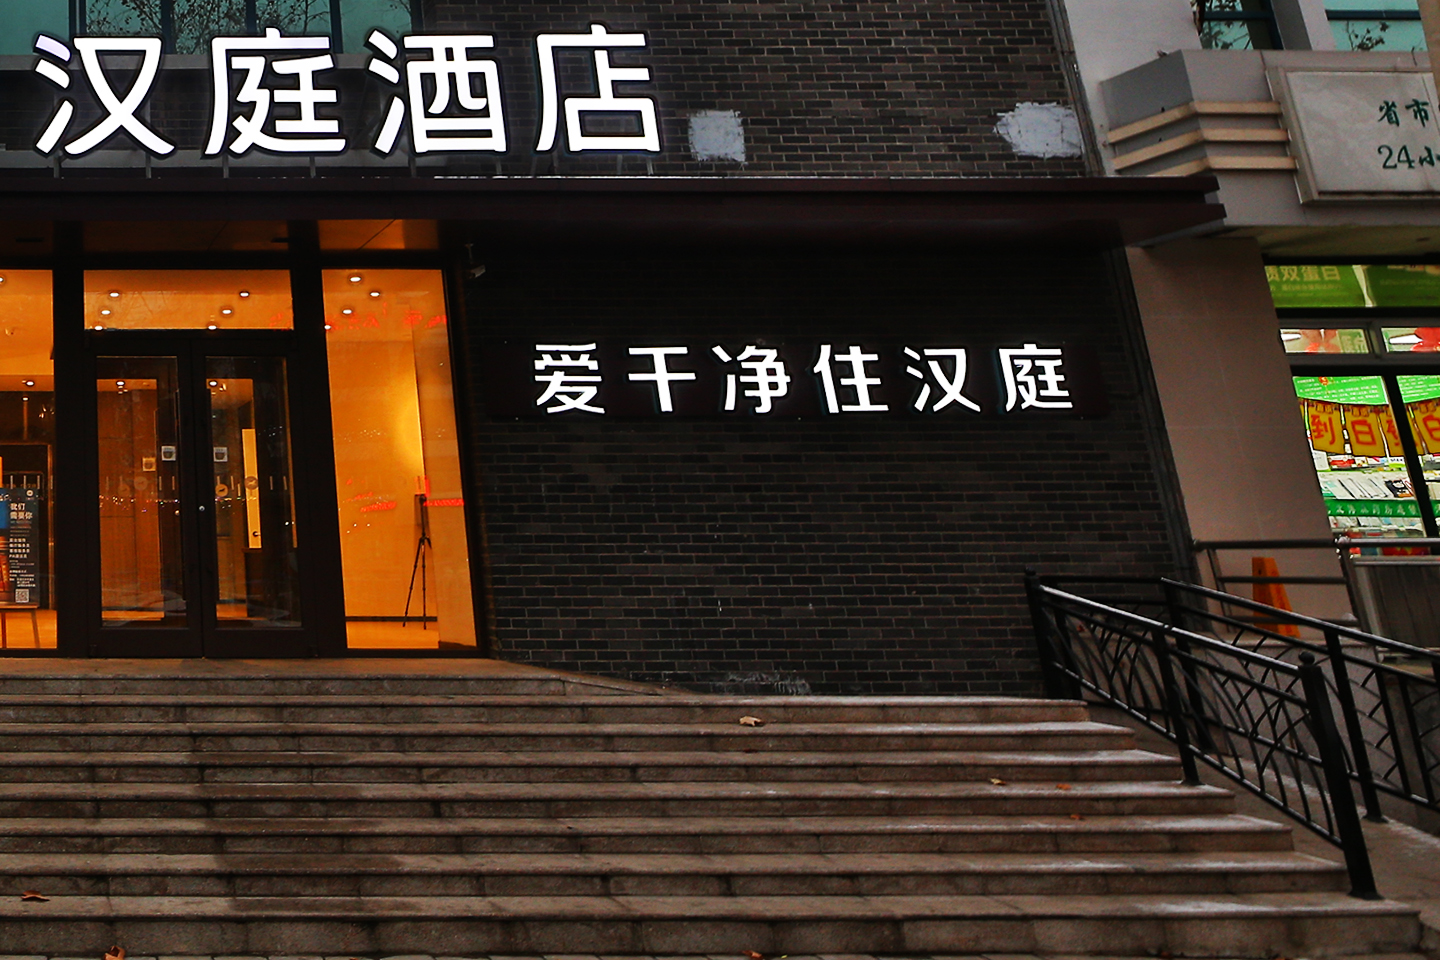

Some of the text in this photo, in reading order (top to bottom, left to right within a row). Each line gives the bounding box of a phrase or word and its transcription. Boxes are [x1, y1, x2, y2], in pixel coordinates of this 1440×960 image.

[34, 24, 662, 156] 汉庭酒店
[533, 343, 1073, 415] 爱干净住汉庭
